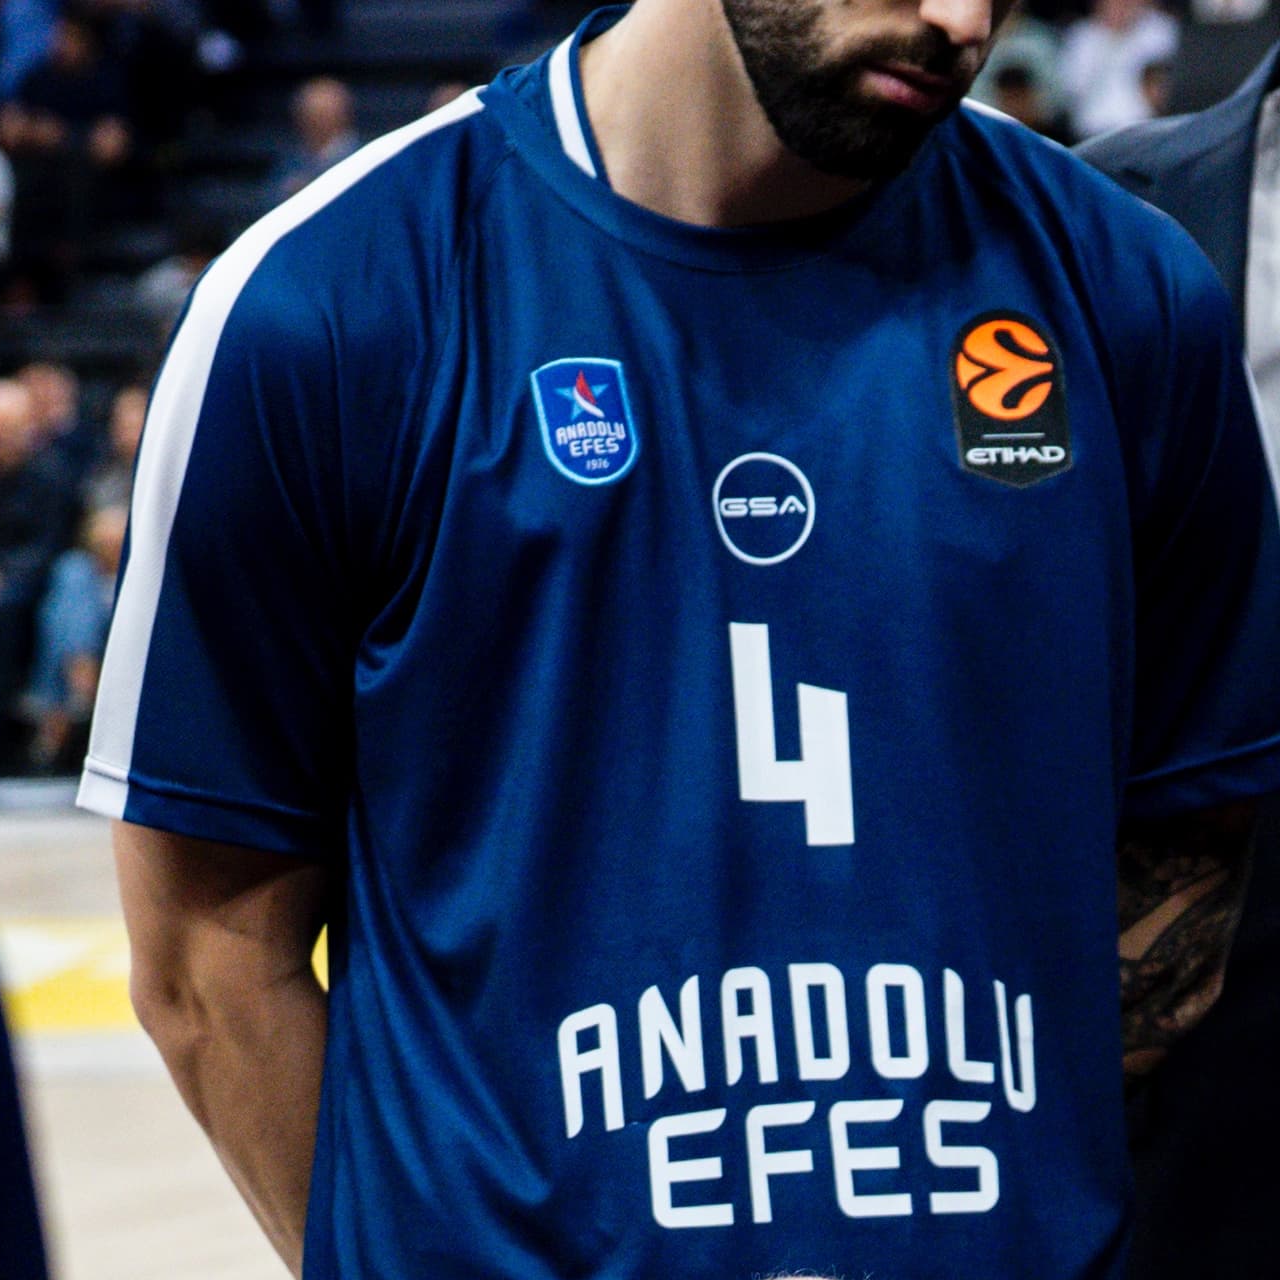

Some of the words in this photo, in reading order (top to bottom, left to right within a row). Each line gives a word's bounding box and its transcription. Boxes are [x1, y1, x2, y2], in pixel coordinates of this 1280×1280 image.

[555, 421, 626, 446] ANADOLU
[569, 437, 620, 457] EFES
[966, 446, 1066, 465] ETIHAD
[720, 495, 807, 517] GSA
[729, 621, 855, 846] 4
[557, 962, 1037, 1139] ANADOLU
[646, 1098, 1000, 1229] EFES
